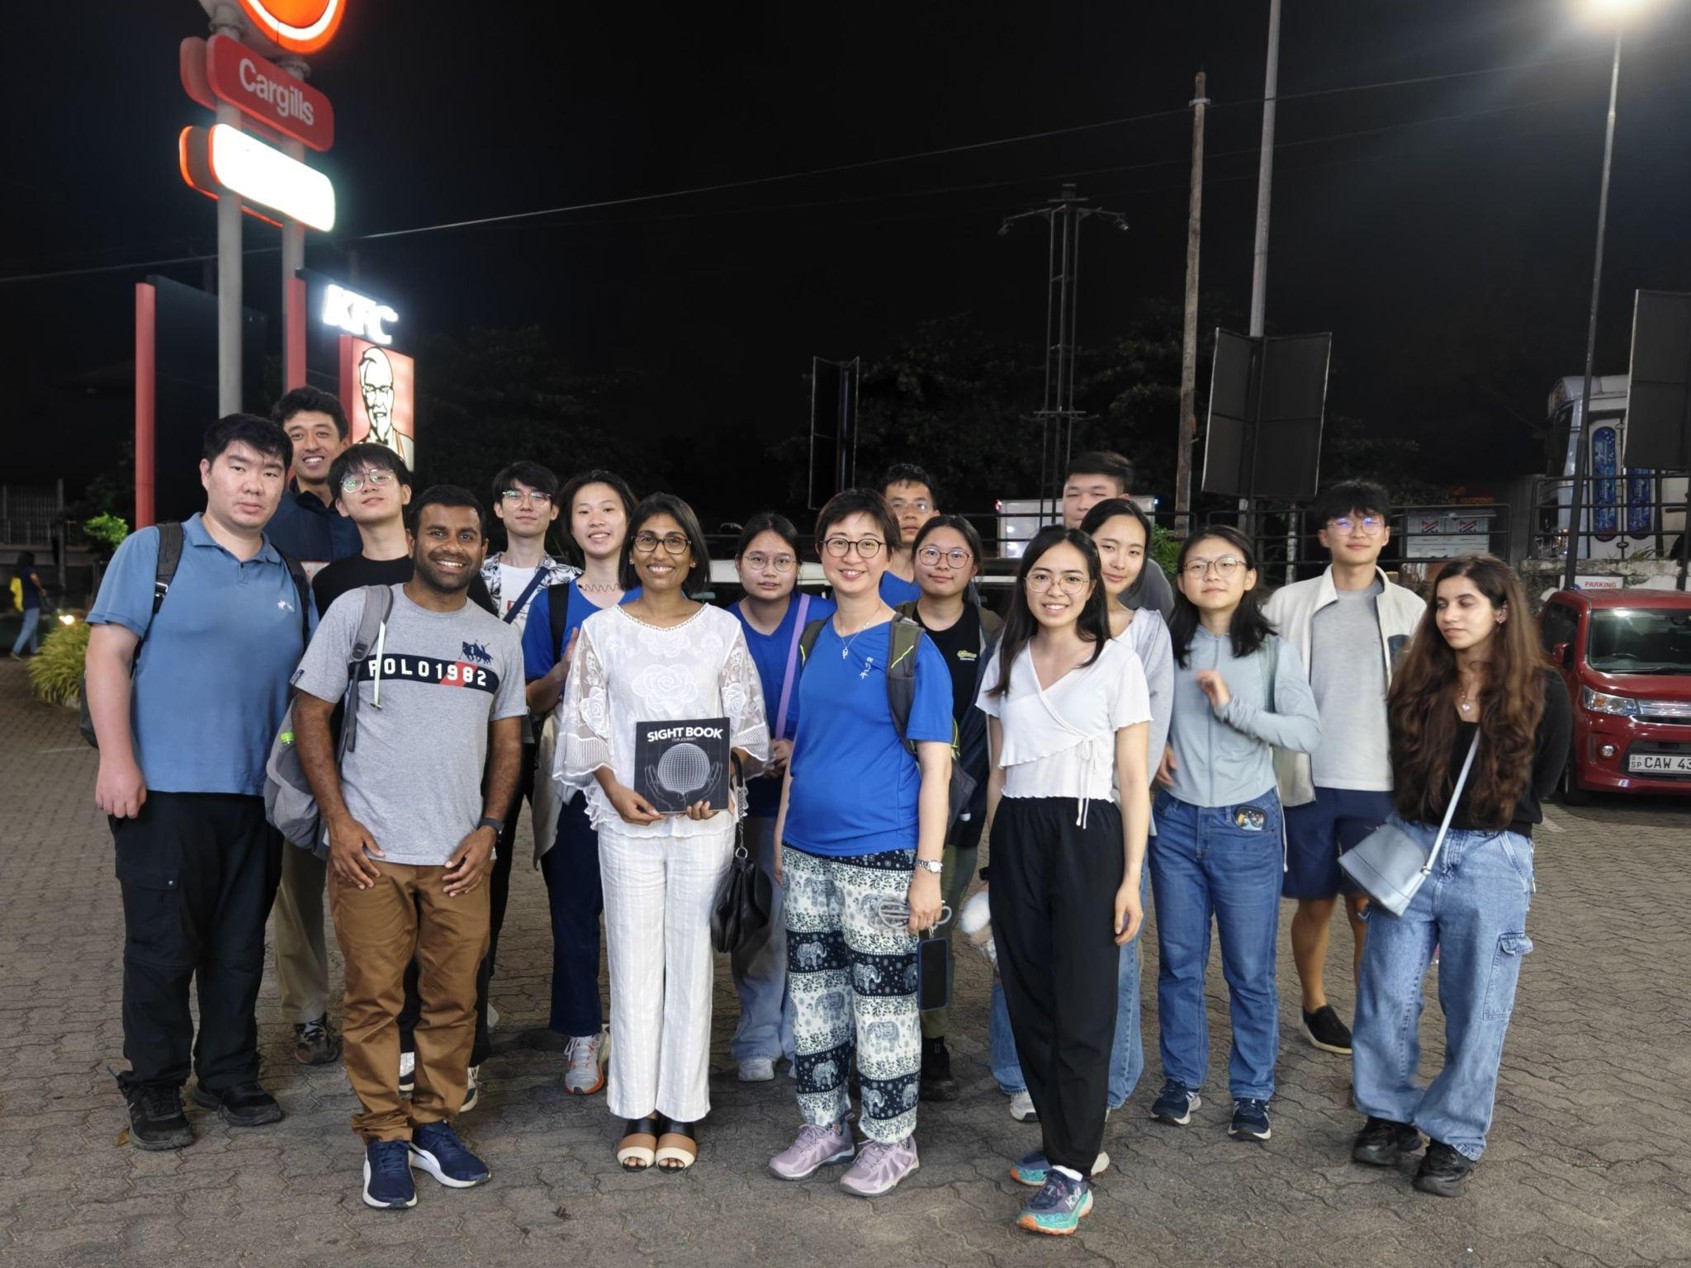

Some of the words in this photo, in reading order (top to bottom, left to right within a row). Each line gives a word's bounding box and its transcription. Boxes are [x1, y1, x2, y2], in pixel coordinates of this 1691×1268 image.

[239, 58, 314, 126] Cargills
[322, 283, 399, 345] KFC
[647, 727, 684, 743] SIGHT
[685, 726, 724, 740] BOOK
[1644, 756, 1672, 769] CAW
